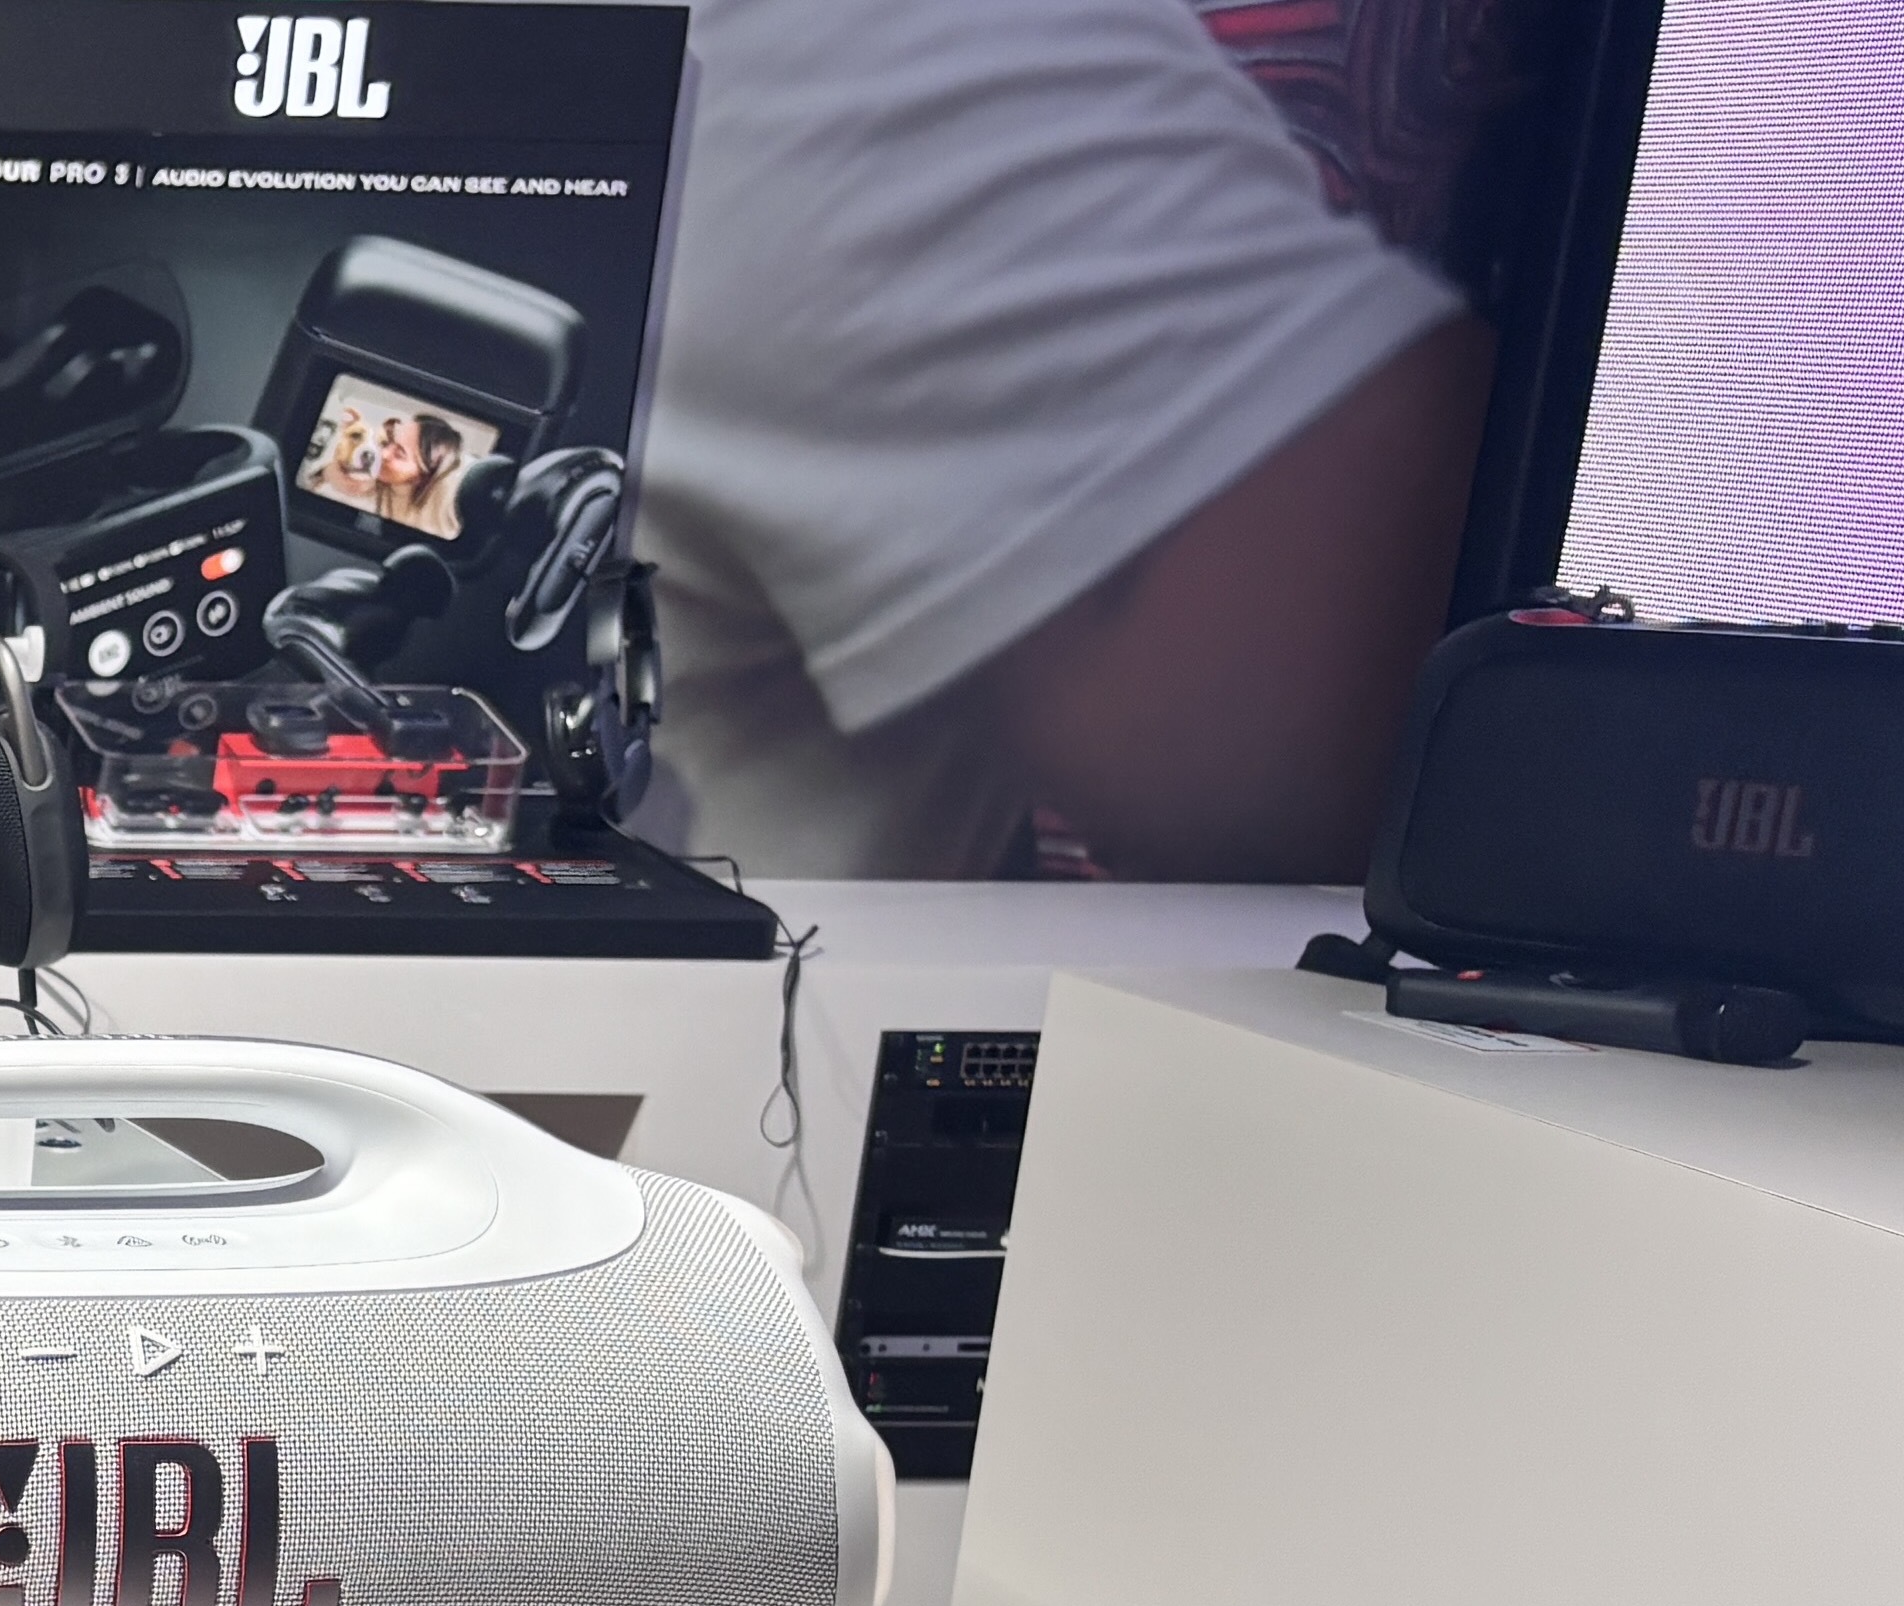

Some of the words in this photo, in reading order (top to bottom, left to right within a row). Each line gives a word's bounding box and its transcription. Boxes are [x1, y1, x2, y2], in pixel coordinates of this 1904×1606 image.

[234, 15, 392, 118] JBL
[49, 161, 107, 184] PRO
[114, 162, 130, 185] 3
[152, 168, 226, 187] AUDIO
[228, 170, 356, 191] EVOLUTION
[360, 174, 409, 192] YOU
[410, 175, 462, 193] CAN
[464, 177, 508, 194] SEE
[510, 178, 562, 196] AND
[563, 179, 628, 196] HEAR
[1692, 778, 1814, 857] JBL
